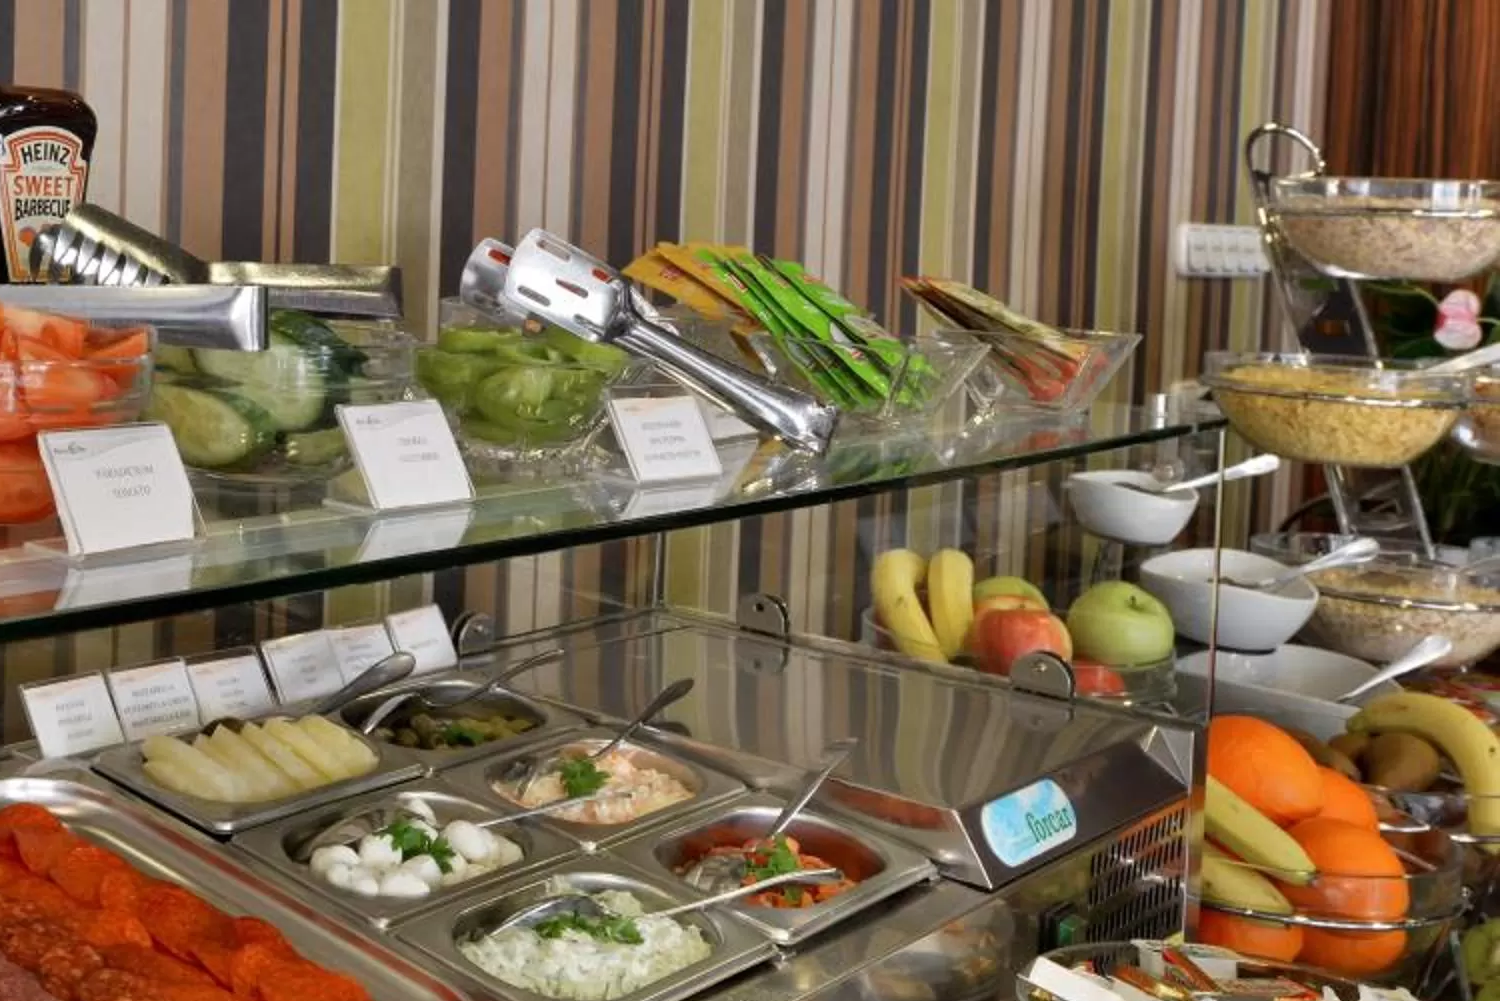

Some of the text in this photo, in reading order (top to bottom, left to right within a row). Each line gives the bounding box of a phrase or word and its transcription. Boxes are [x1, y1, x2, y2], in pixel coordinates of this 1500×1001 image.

[20, 142, 71, 165] HEINZ
[13, 175, 75, 197] SWEET
[15, 198, 71, 221] BARBECUE
